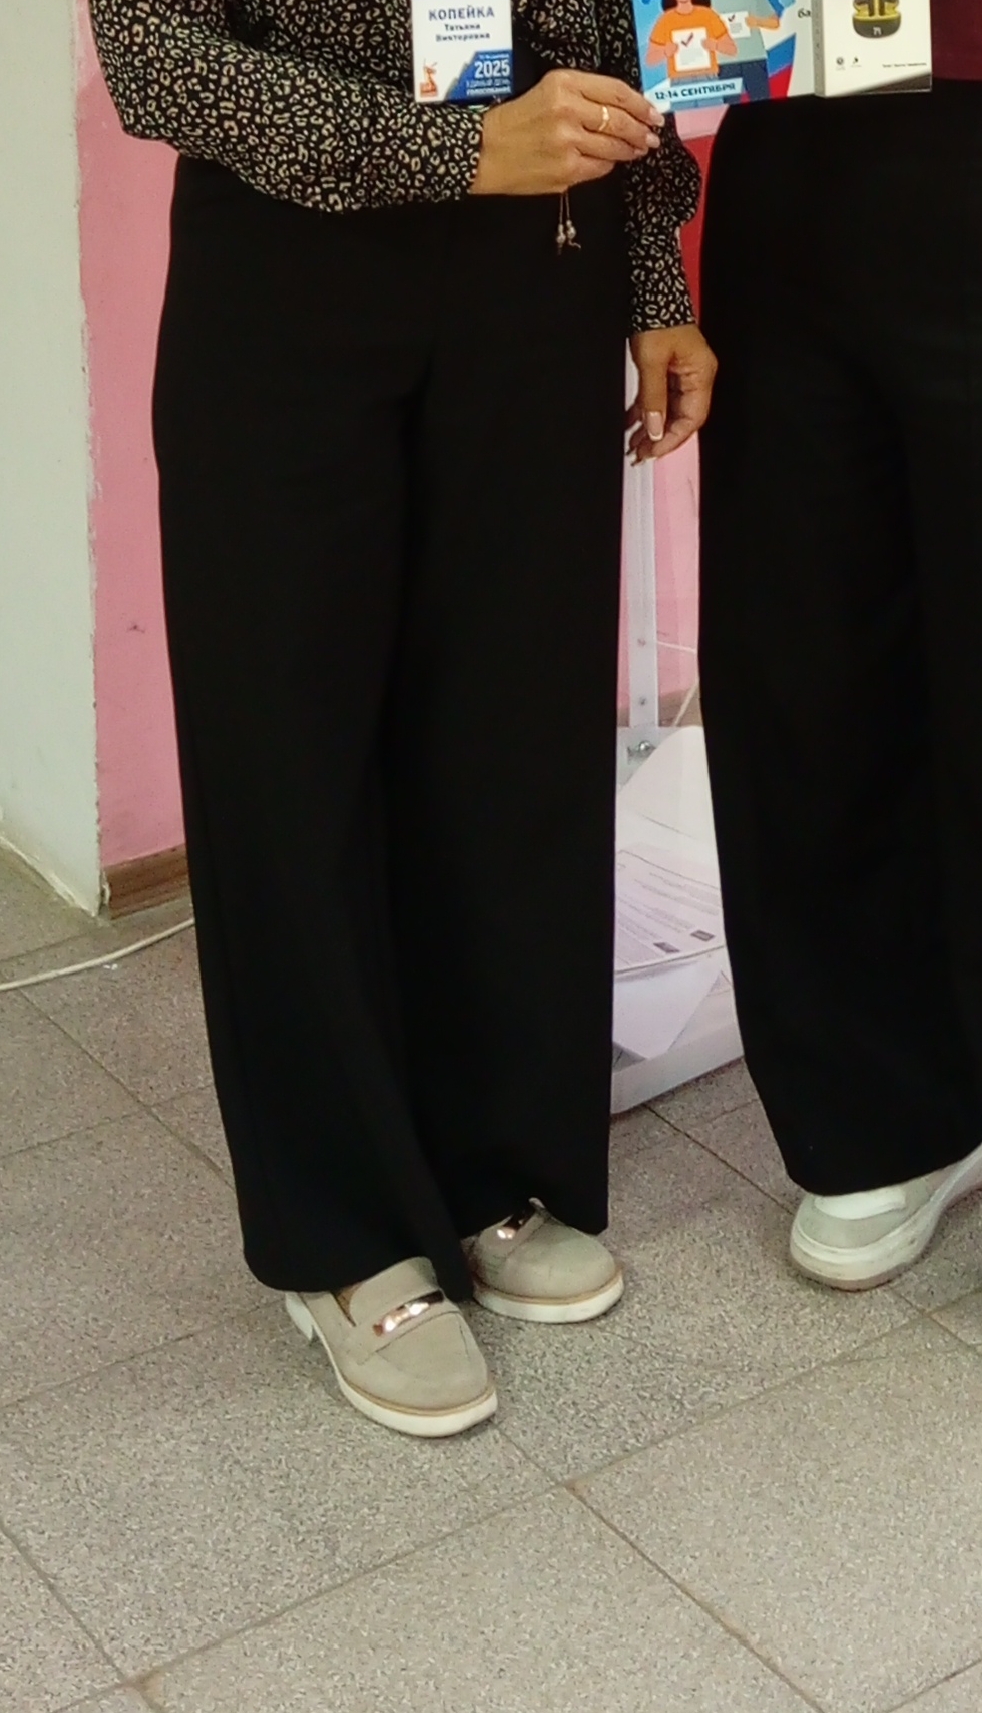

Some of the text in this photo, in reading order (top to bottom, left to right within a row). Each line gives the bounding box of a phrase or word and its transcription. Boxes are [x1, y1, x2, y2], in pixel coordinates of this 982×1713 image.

[429, 5, 495, 21] КОПЕЙКА
[444, 23, 481, 32] Татьяна
[436, 33, 490, 42] Викторовна
[474, 59, 510, 78] 2025
[655, 83, 736, 100] 12-14 СЕНТЯБРЯ
